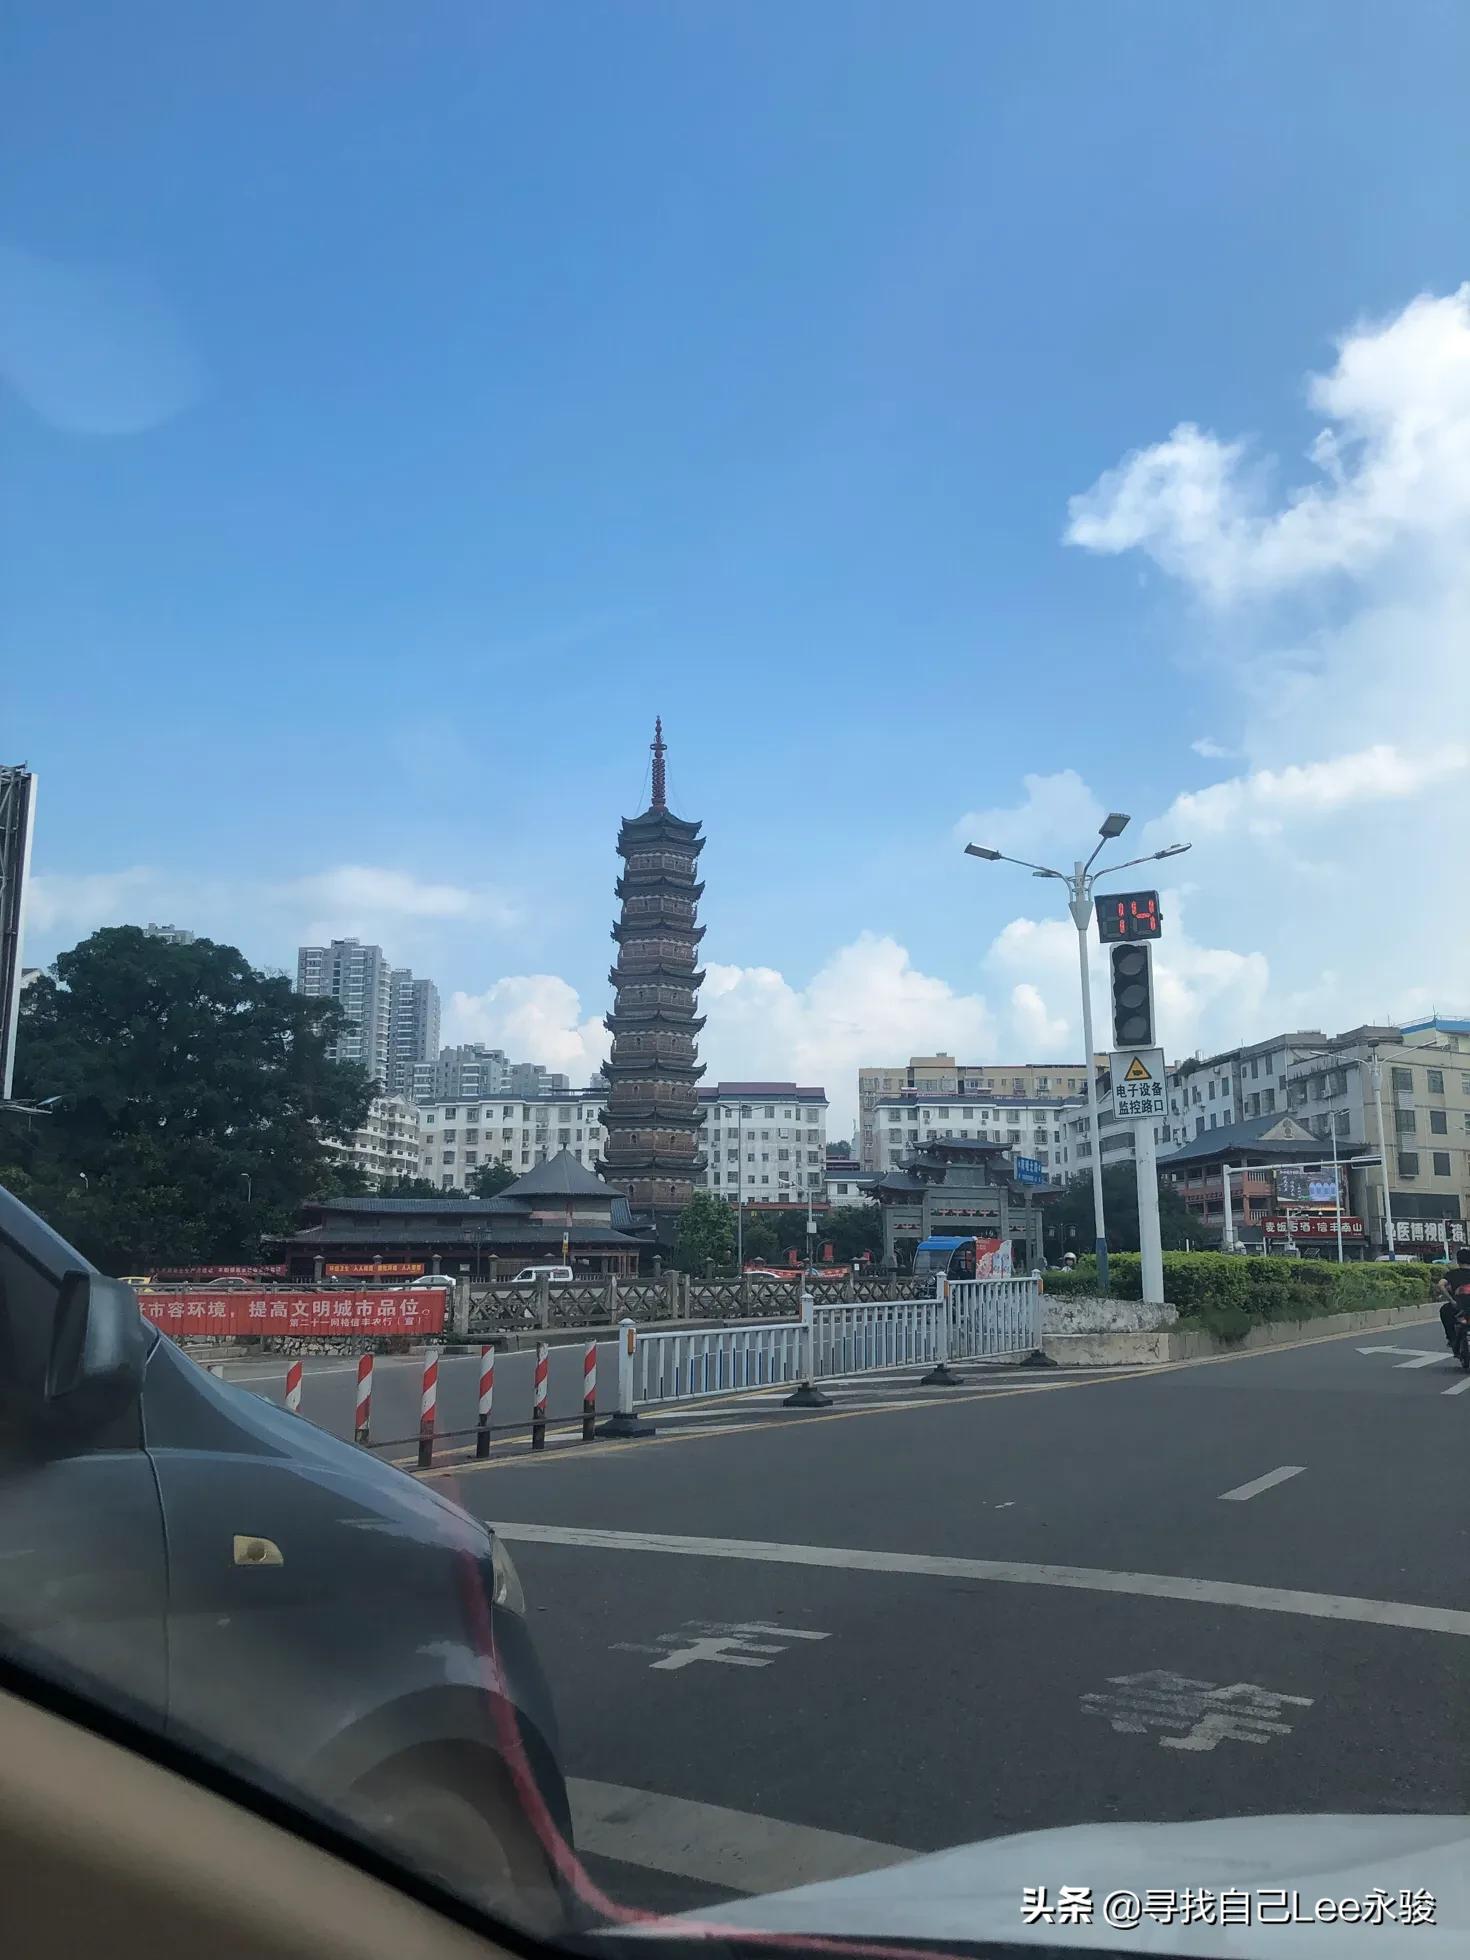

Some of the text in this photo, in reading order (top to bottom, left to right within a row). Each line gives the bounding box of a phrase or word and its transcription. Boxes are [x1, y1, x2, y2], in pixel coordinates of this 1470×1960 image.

[1117, 899, 1156, 933] 14
[1116, 1081, 1163, 1098] 电子设备
[1118, 1099, 1165, 1115] 监控路口
